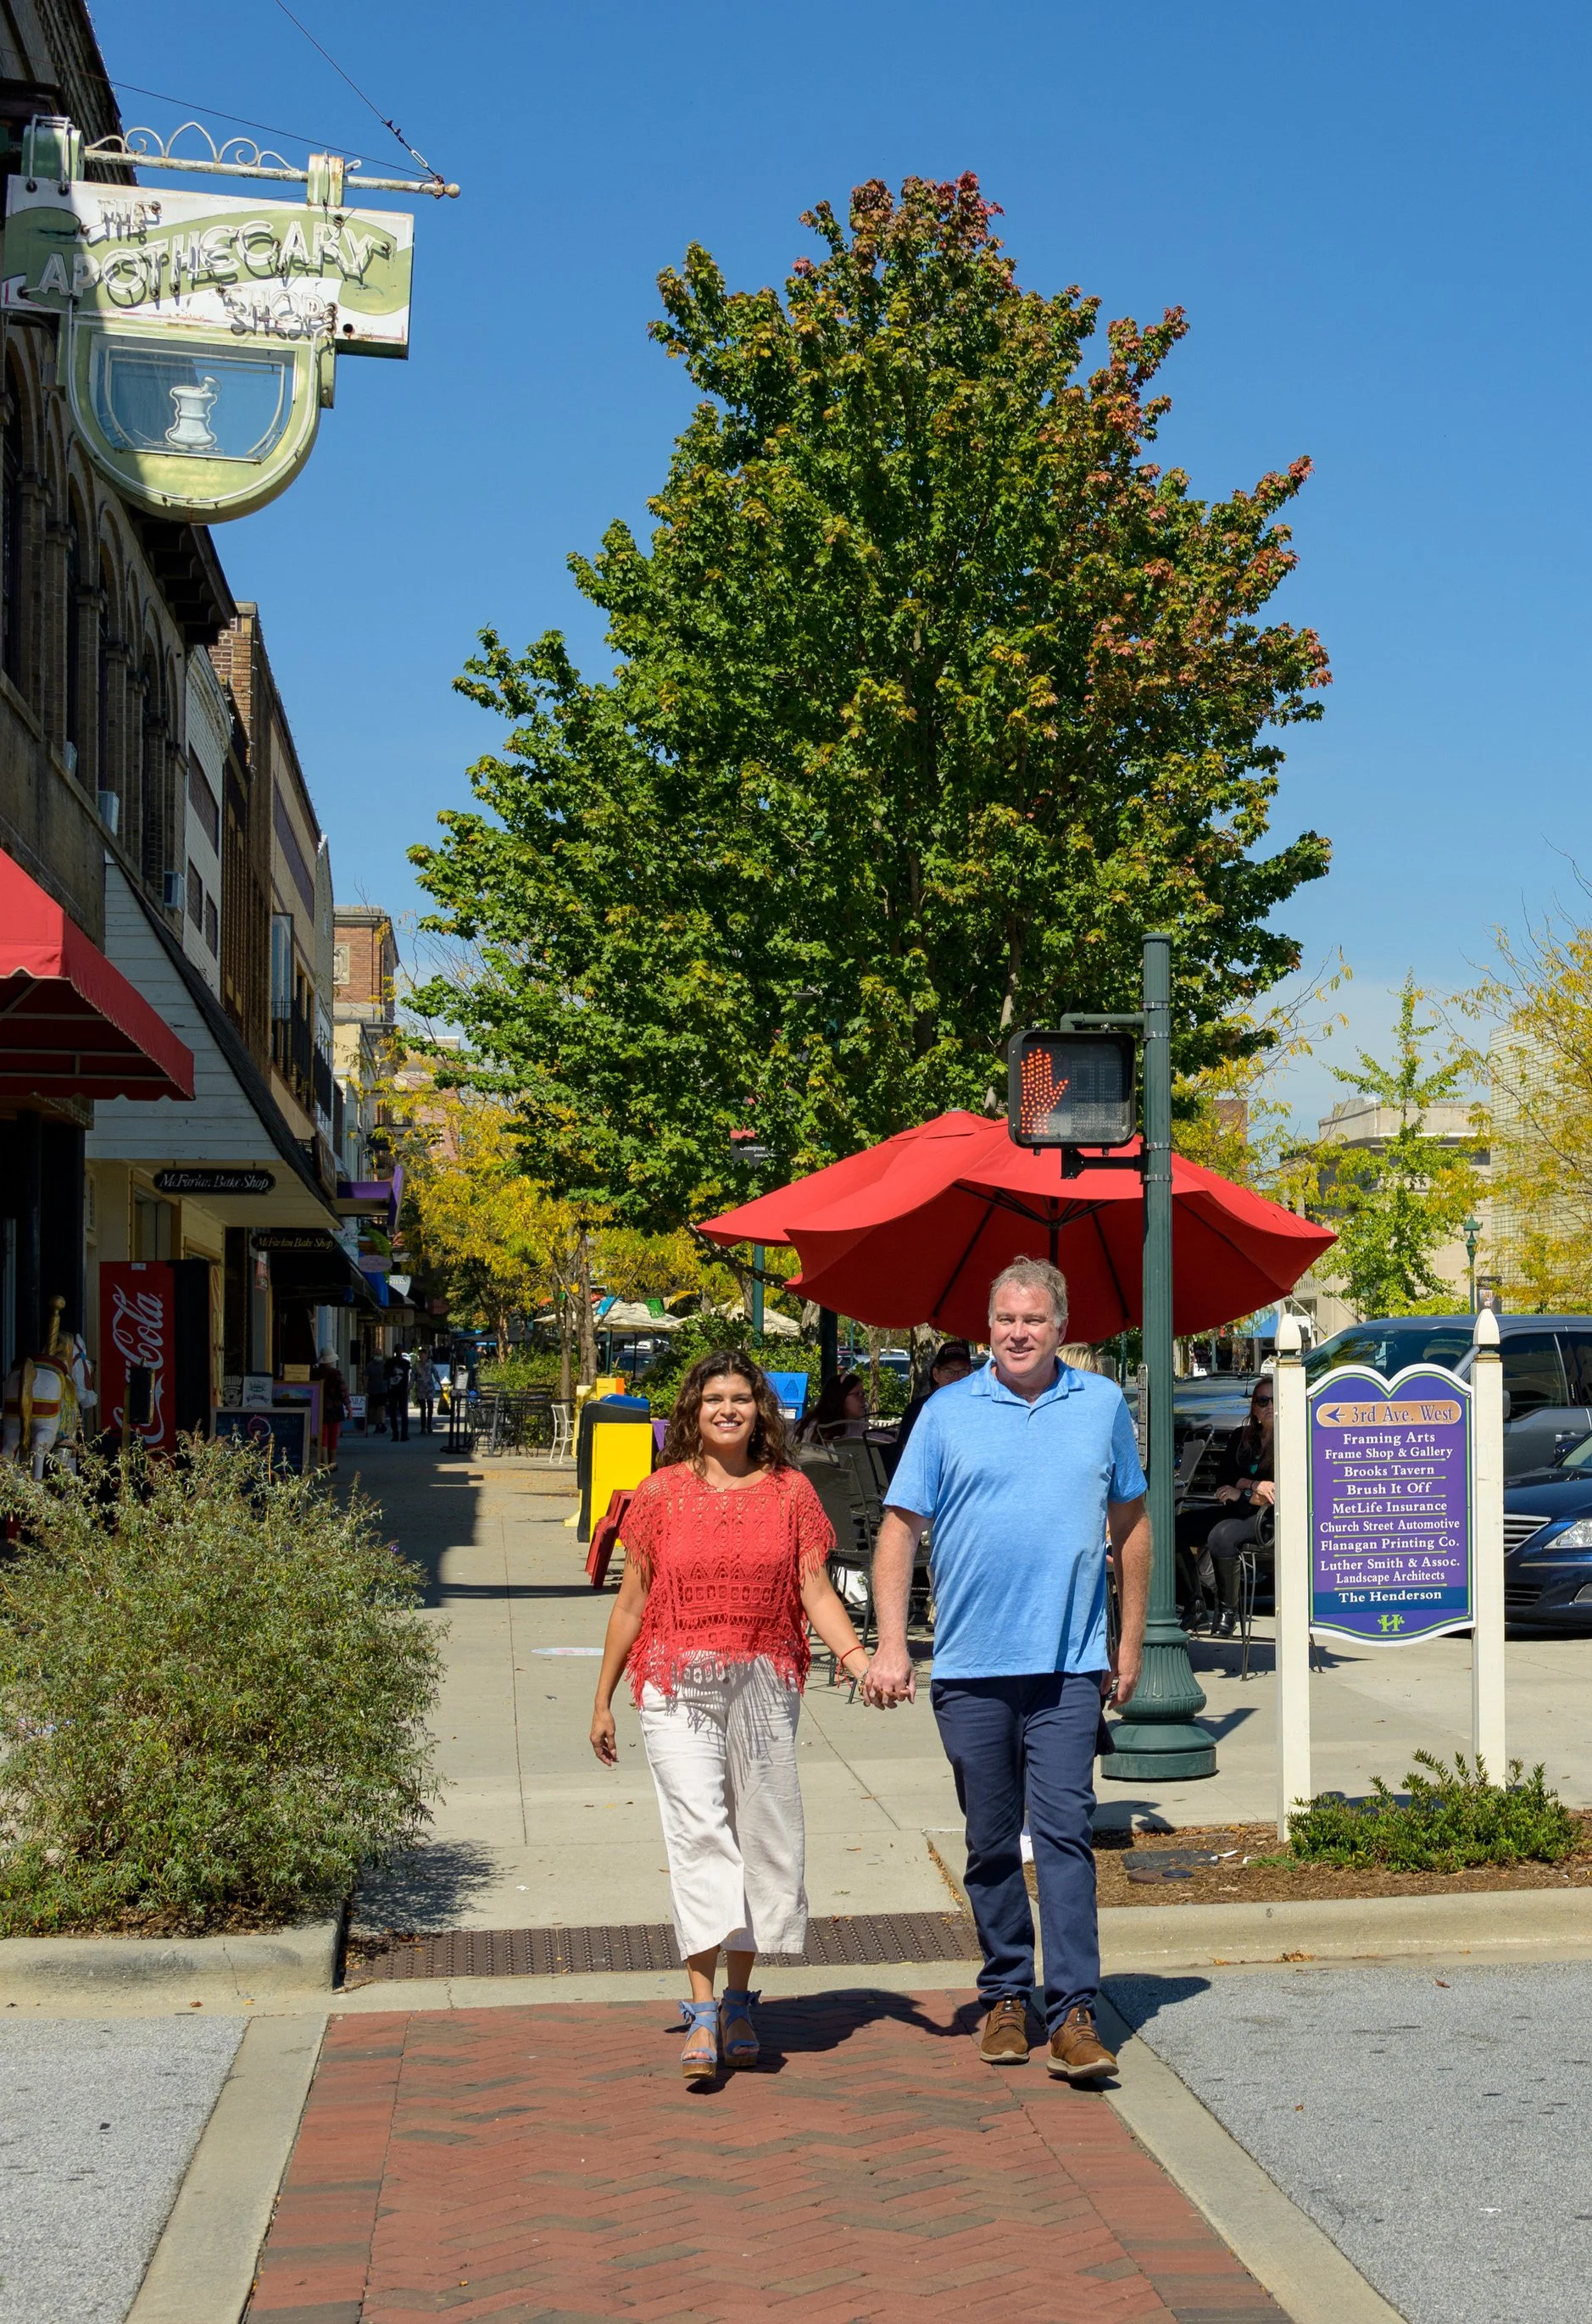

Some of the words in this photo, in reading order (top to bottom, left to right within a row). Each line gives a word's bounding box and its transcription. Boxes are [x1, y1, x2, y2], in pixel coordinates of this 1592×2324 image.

[97, 199, 151, 231] THE
[39, 220, 375, 297] APOTHECARY
[225, 286, 329, 323] SHOP
[213, 1174, 241, 1187] Bake
[242, 1174, 270, 1191] Shop
[293, 1237, 314, 1248] Bake
[314, 1237, 333, 1249] Shop
[1351, 1405, 1376, 1423] 3rd
[1383, 1405, 1414, 1422] Ave.
[1420, 1404, 1453, 1421] West
[1343, 1432, 1401, 1446] Framing
[1406, 1432, 1435, 1443] Arts
[1325, 1449, 1362, 1459] Frame
[1366, 1448, 1394, 1459] Shop
[1398, 1448, 1407, 1457] &
[1410, 1447, 1453, 1458] Gallery
[1344, 1466, 1388, 1477] Brooks
[1391, 1465, 1434, 1476] Tavern
[1347, 1484, 1386, 1495] Brush
[1390, 1483, 1401, 1494] It
[1407, 1482, 1432, 1493] Off
[1332, 1502, 1383, 1514] MetLife
[1386, 1501, 1448, 1512] Insurance
[1320, 1521, 1359, 1533] Church
[1363, 1520, 1394, 1532] Street
[1398, 1518, 1460, 1530] Automotive
[1321, 1540, 1378, 1553] Flanagan
[1382, 1537, 1434, 1550] Printing
[1439, 1536, 1460, 1547] Co.
[1320, 1560, 1363, 1571] Luther
[1367, 1558, 1403, 1569] Smith
[1408, 1558, 1418, 1567] &
[1422, 1556, 1460, 1567] Assoc.
[1336, 1573, 1390, 1585] Landscape
[1393, 1570, 1445, 1582] Architects
[1339, 1593, 1366, 1604] The
[1369, 1589, 1443, 1602] Henderson
